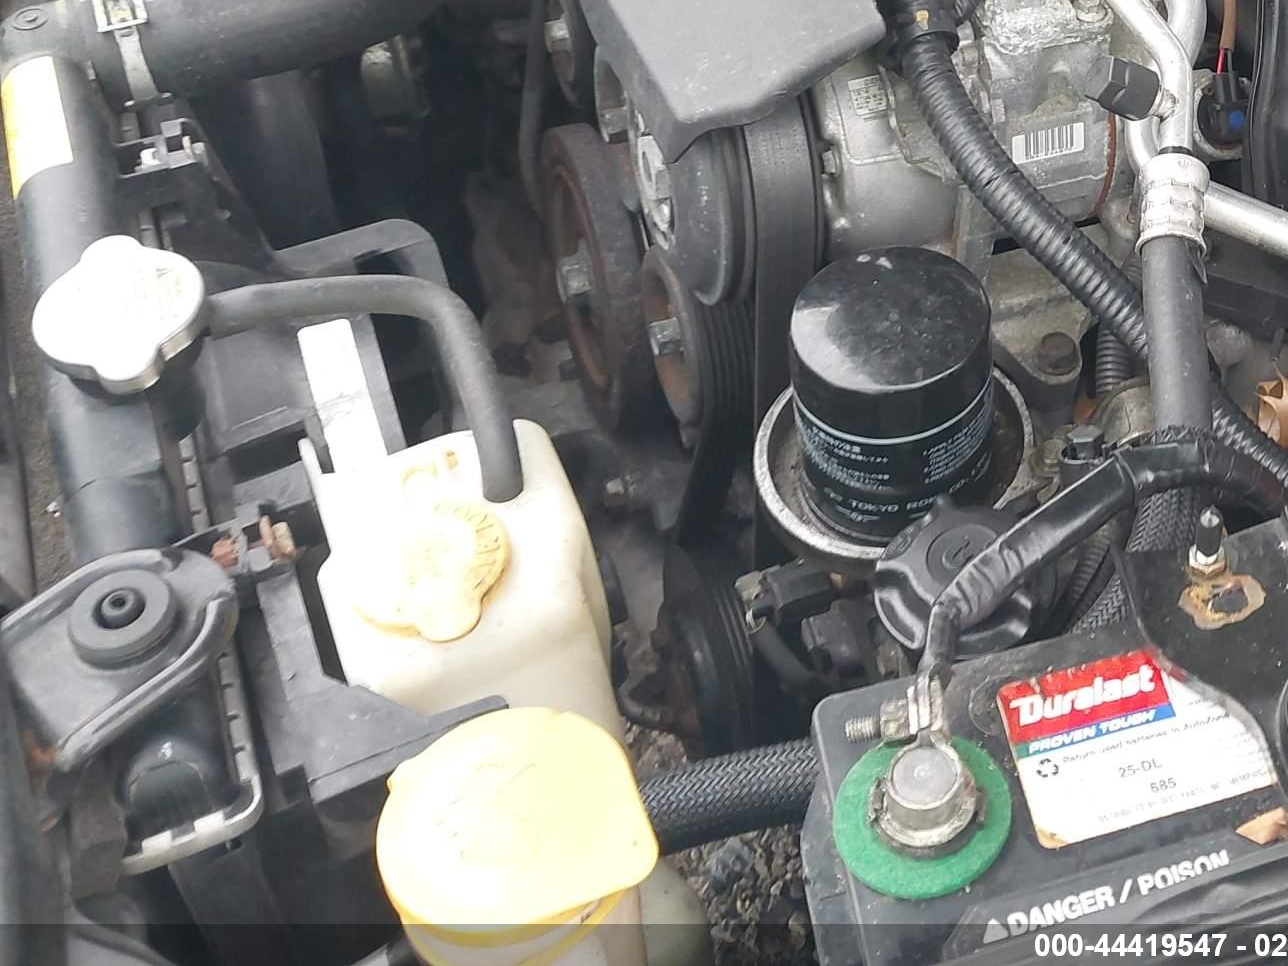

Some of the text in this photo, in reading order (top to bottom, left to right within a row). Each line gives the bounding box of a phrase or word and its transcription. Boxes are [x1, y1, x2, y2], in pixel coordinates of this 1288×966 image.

[849, 498, 899, 514] TOKYO
[1009, 664, 1156, 726] Duralast
[1028, 709, 1156, 755] PROVEN TOUGH
[1118, 758, 1163, 779] 25-DL
[1150, 777, 1177, 794] 685
[1007, 849, 1231, 936] DANGER / POISON
